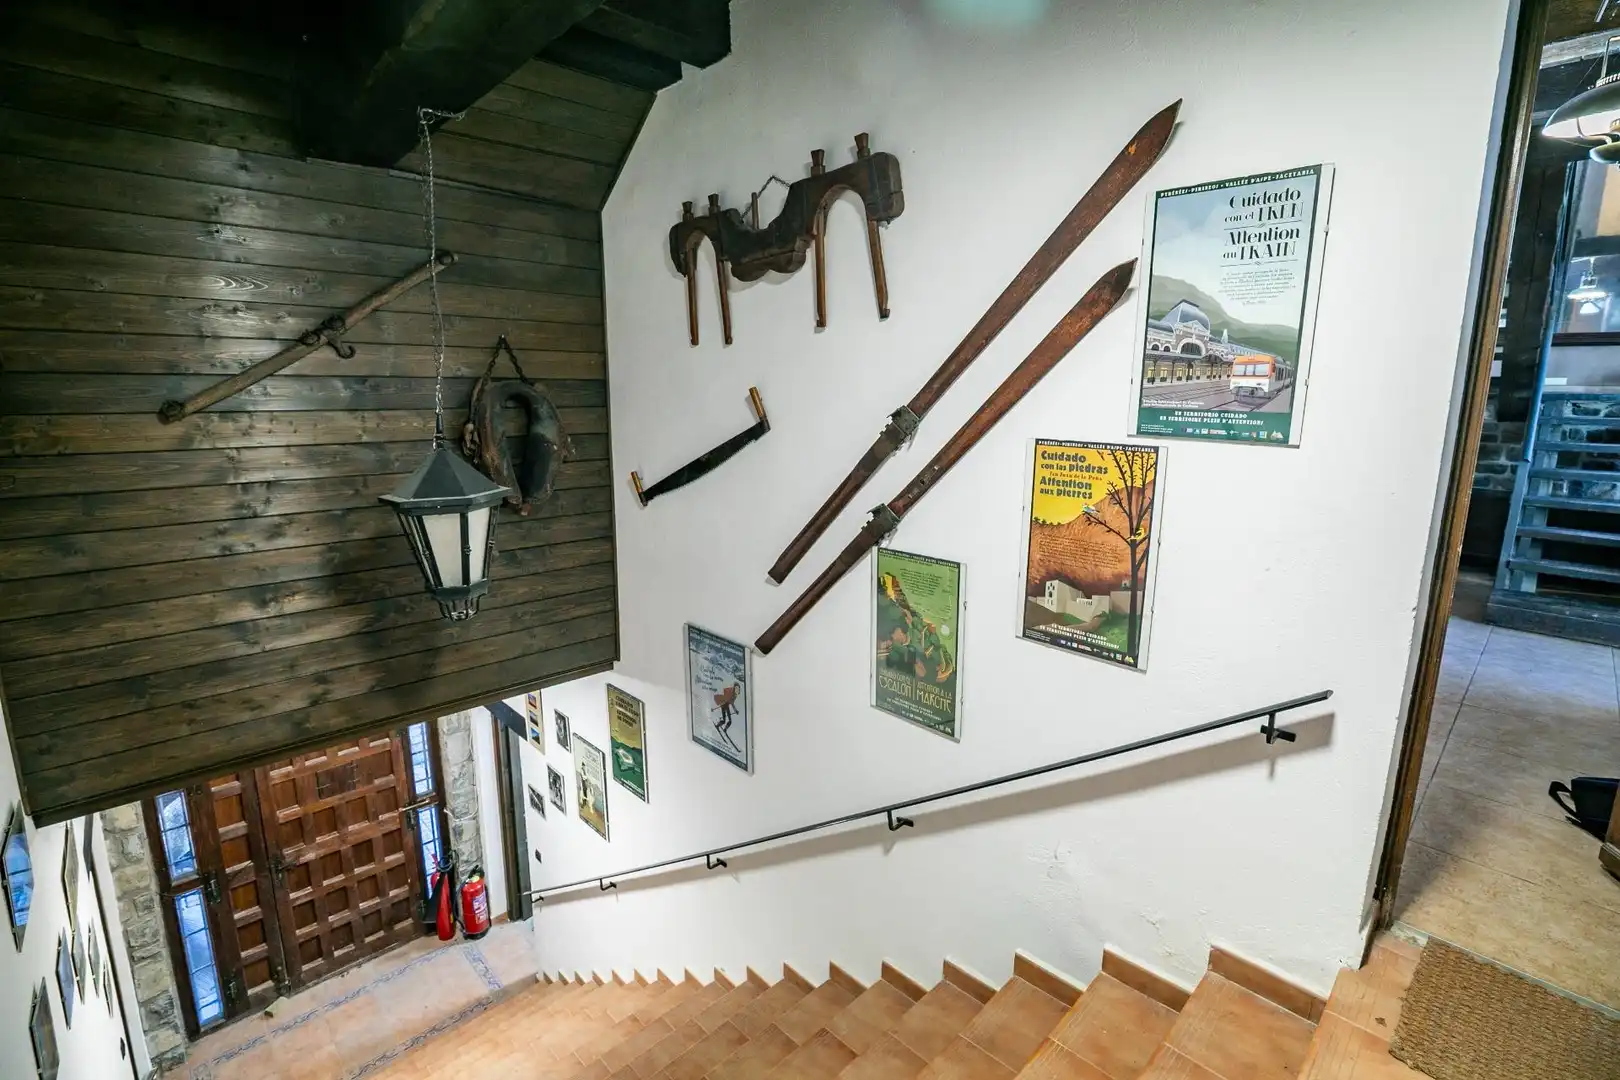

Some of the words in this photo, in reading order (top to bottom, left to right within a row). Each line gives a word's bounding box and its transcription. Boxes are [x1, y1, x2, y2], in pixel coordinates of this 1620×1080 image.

[1230, 189, 1301, 209] Cuidado
[1224, 214, 1242, 223] con
[1257, 202, 1304, 222] TREN
[1225, 227, 1300, 247] Attention
[1239, 241, 1296, 260] TRAIN
[1041, 450, 1087, 463] Cuidado
[1056, 463, 1067, 471] las
[1068, 463, 1109, 475] piedras
[1040, 475, 1093, 490] Attention
[1056, 488, 1093, 499] pierres
